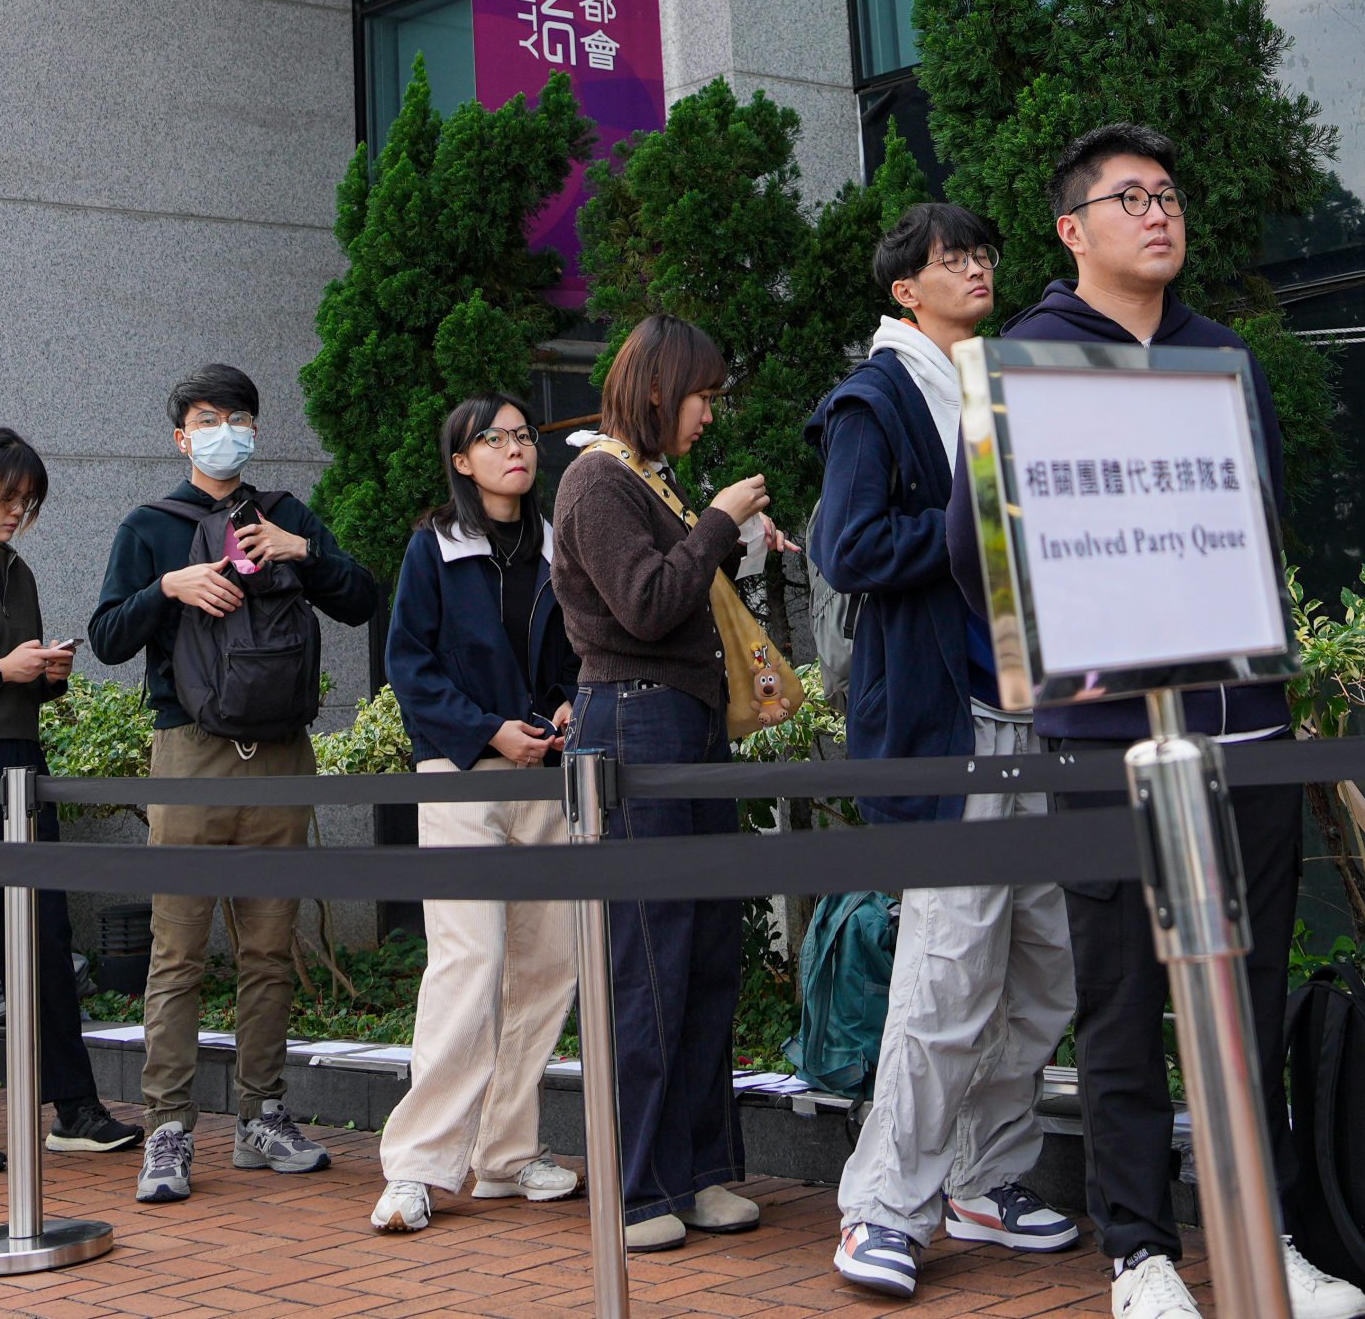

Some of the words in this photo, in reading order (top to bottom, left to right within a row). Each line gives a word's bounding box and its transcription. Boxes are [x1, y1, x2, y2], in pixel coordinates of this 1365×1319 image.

[1025, 457, 1240, 498] 相關團體代表排隊處
[1039, 530, 1128, 560] Involved
[1134, 528, 1185, 559] Party
[1191, 523, 1246, 556] Queue
[1133, 1247, 1149, 1262] STAR
